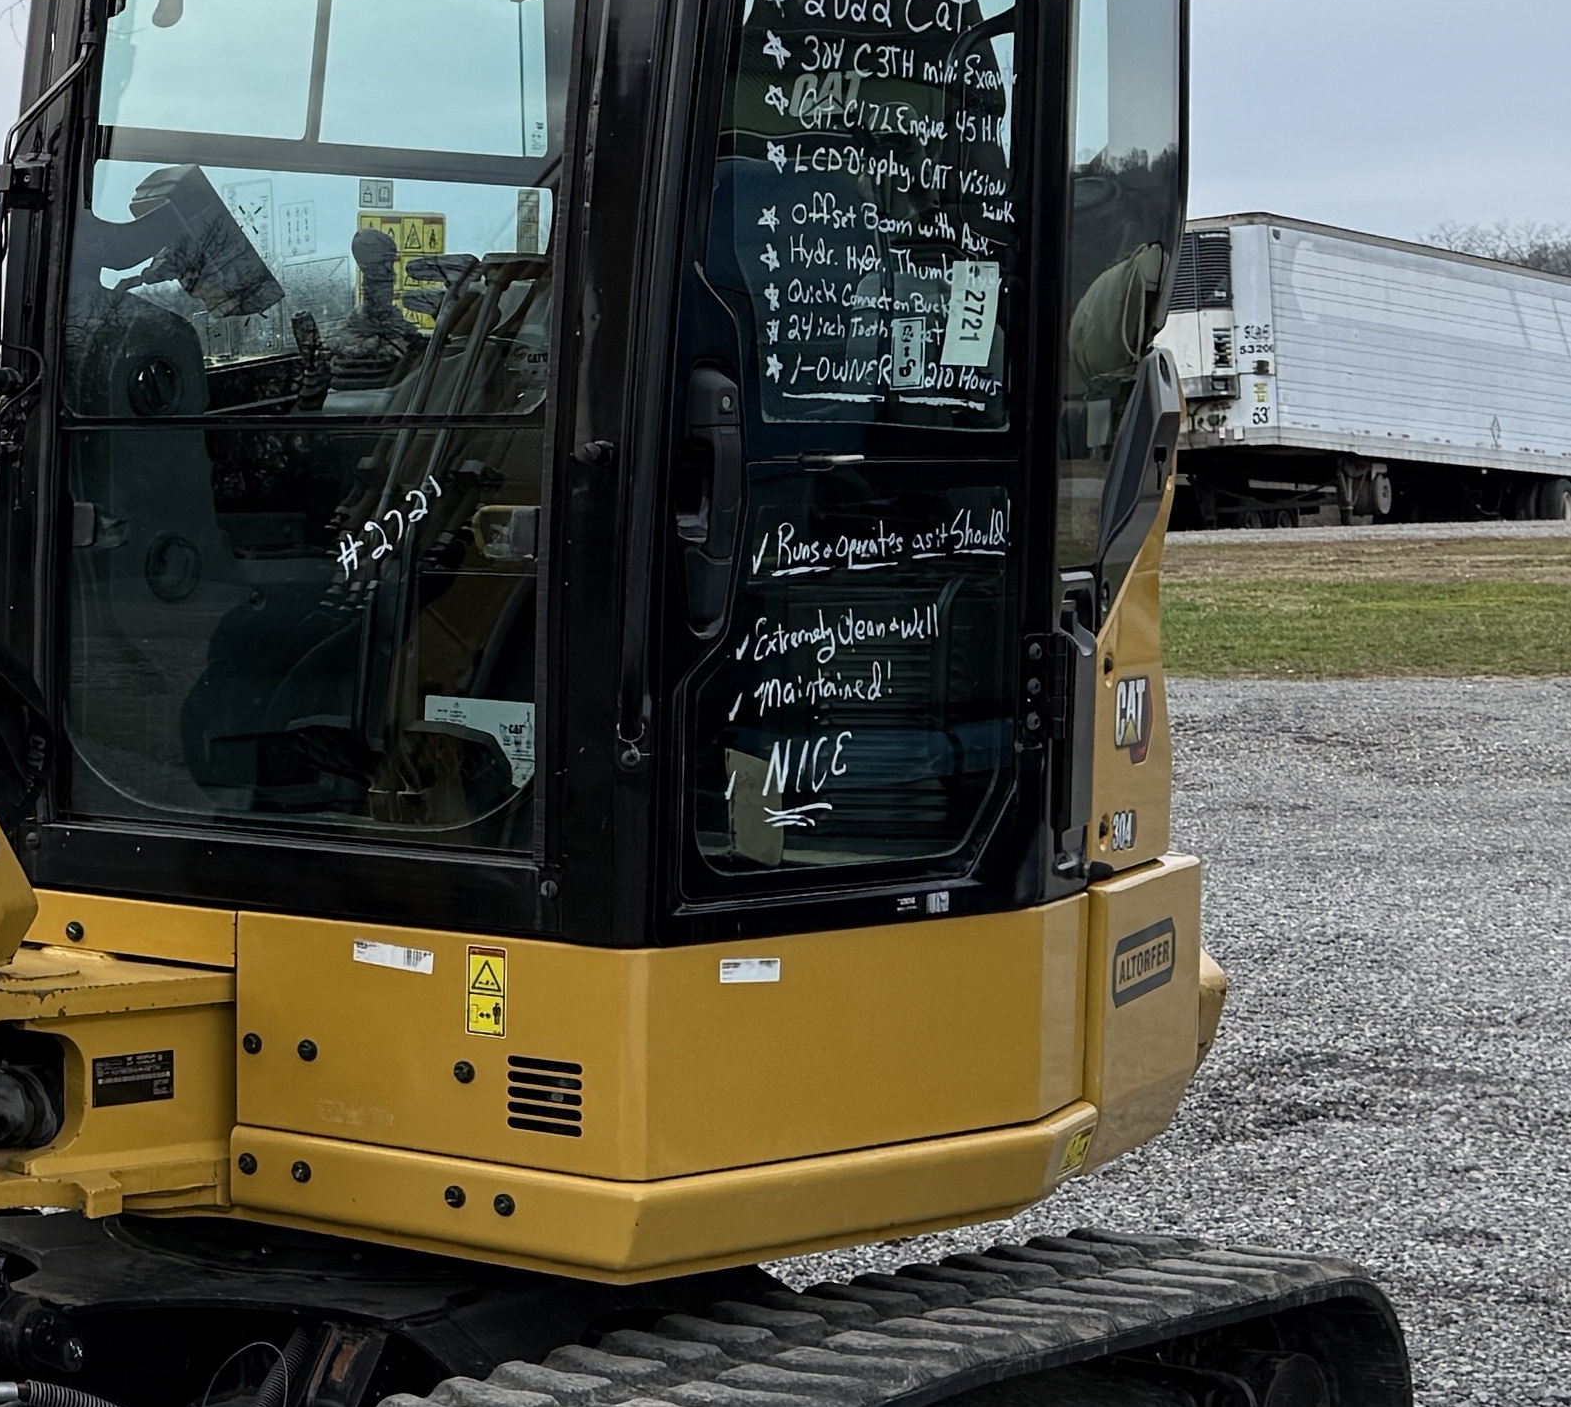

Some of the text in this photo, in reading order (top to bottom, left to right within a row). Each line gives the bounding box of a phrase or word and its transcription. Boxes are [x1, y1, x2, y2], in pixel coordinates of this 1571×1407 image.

[801, 35, 845, 71] 304
[789, 71, 863, 117] CAT
[897, 104, 948, 145] Engine
[956, 110, 976, 142] 45
[794, 144, 842, 173] LCD
[920, 157, 953, 189] CAT
[791, 191, 857, 229] Offset
[861, 202, 912, 236] Boom
[918, 211, 955, 241] with
[889, 248, 954, 285] Thumb
[788, 278, 837, 306] Quick
[841, 285, 893, 311] Connect
[893, 298, 910, 313] on
[960, 290, 986, 342] 2721
[787, 311, 813, 341] 24
[817, 312, 845, 339] inch
[851, 316, 888, 338] Tooth
[925, 362, 954, 390] 210
[958, 367, 1002, 395] Hours
[337, 475, 442, 581] #2721
[777, 522, 819, 567] Runs
[753, 608, 835, 663] Extremely
[1114, 679, 1148, 747] CAT
[762, 731, 852, 796] NICE
[1111, 811, 1134, 851] 304
[1119, 937, 1171, 985] ALTORFER
